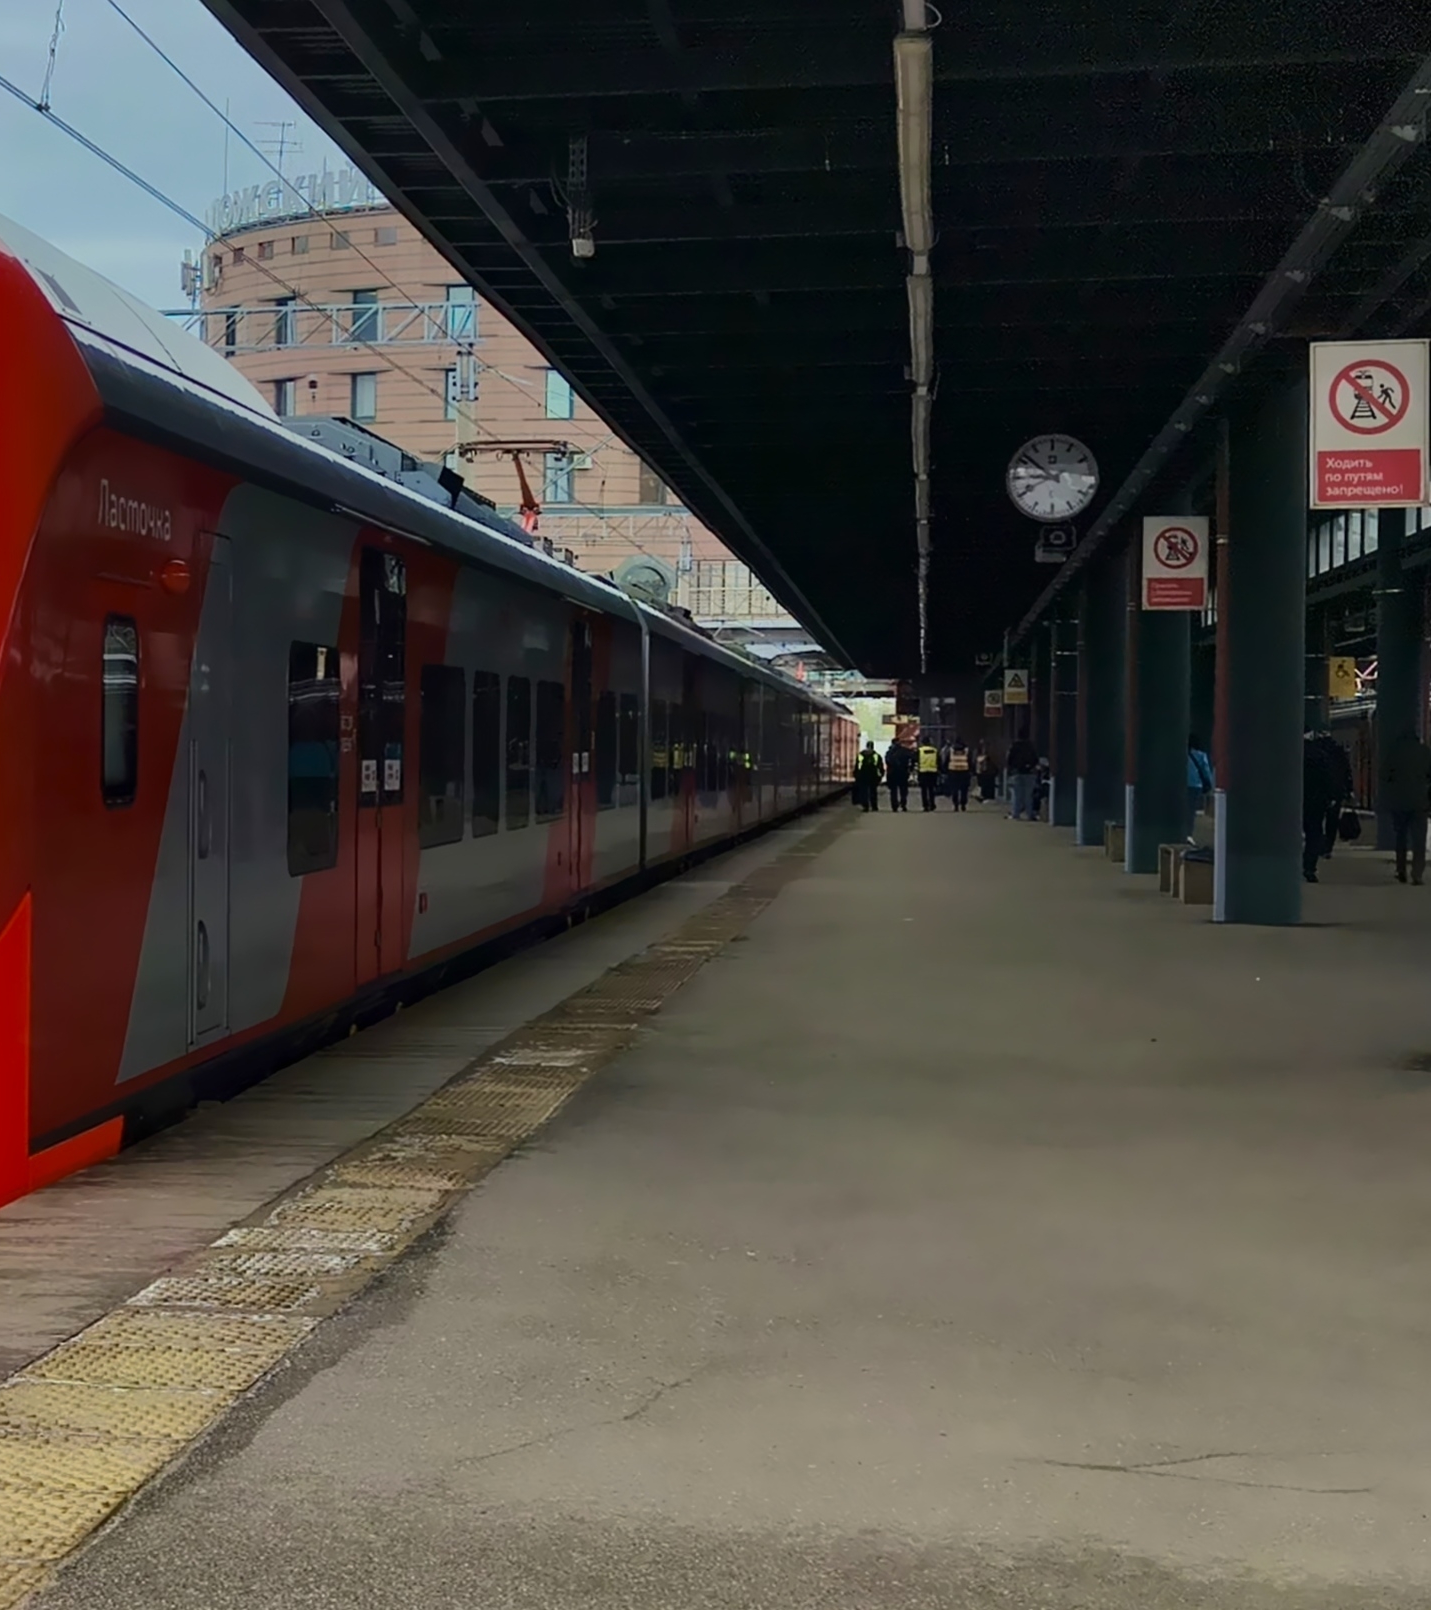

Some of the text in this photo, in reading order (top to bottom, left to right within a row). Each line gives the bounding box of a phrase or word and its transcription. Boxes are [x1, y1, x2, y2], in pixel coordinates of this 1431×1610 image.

[1326, 457, 1373, 470] Ходить
[1325, 472, 1383, 485] по путям
[1325, 484, 1404, 497] запрещено!
[98, 478, 171, 541] Ласточка
